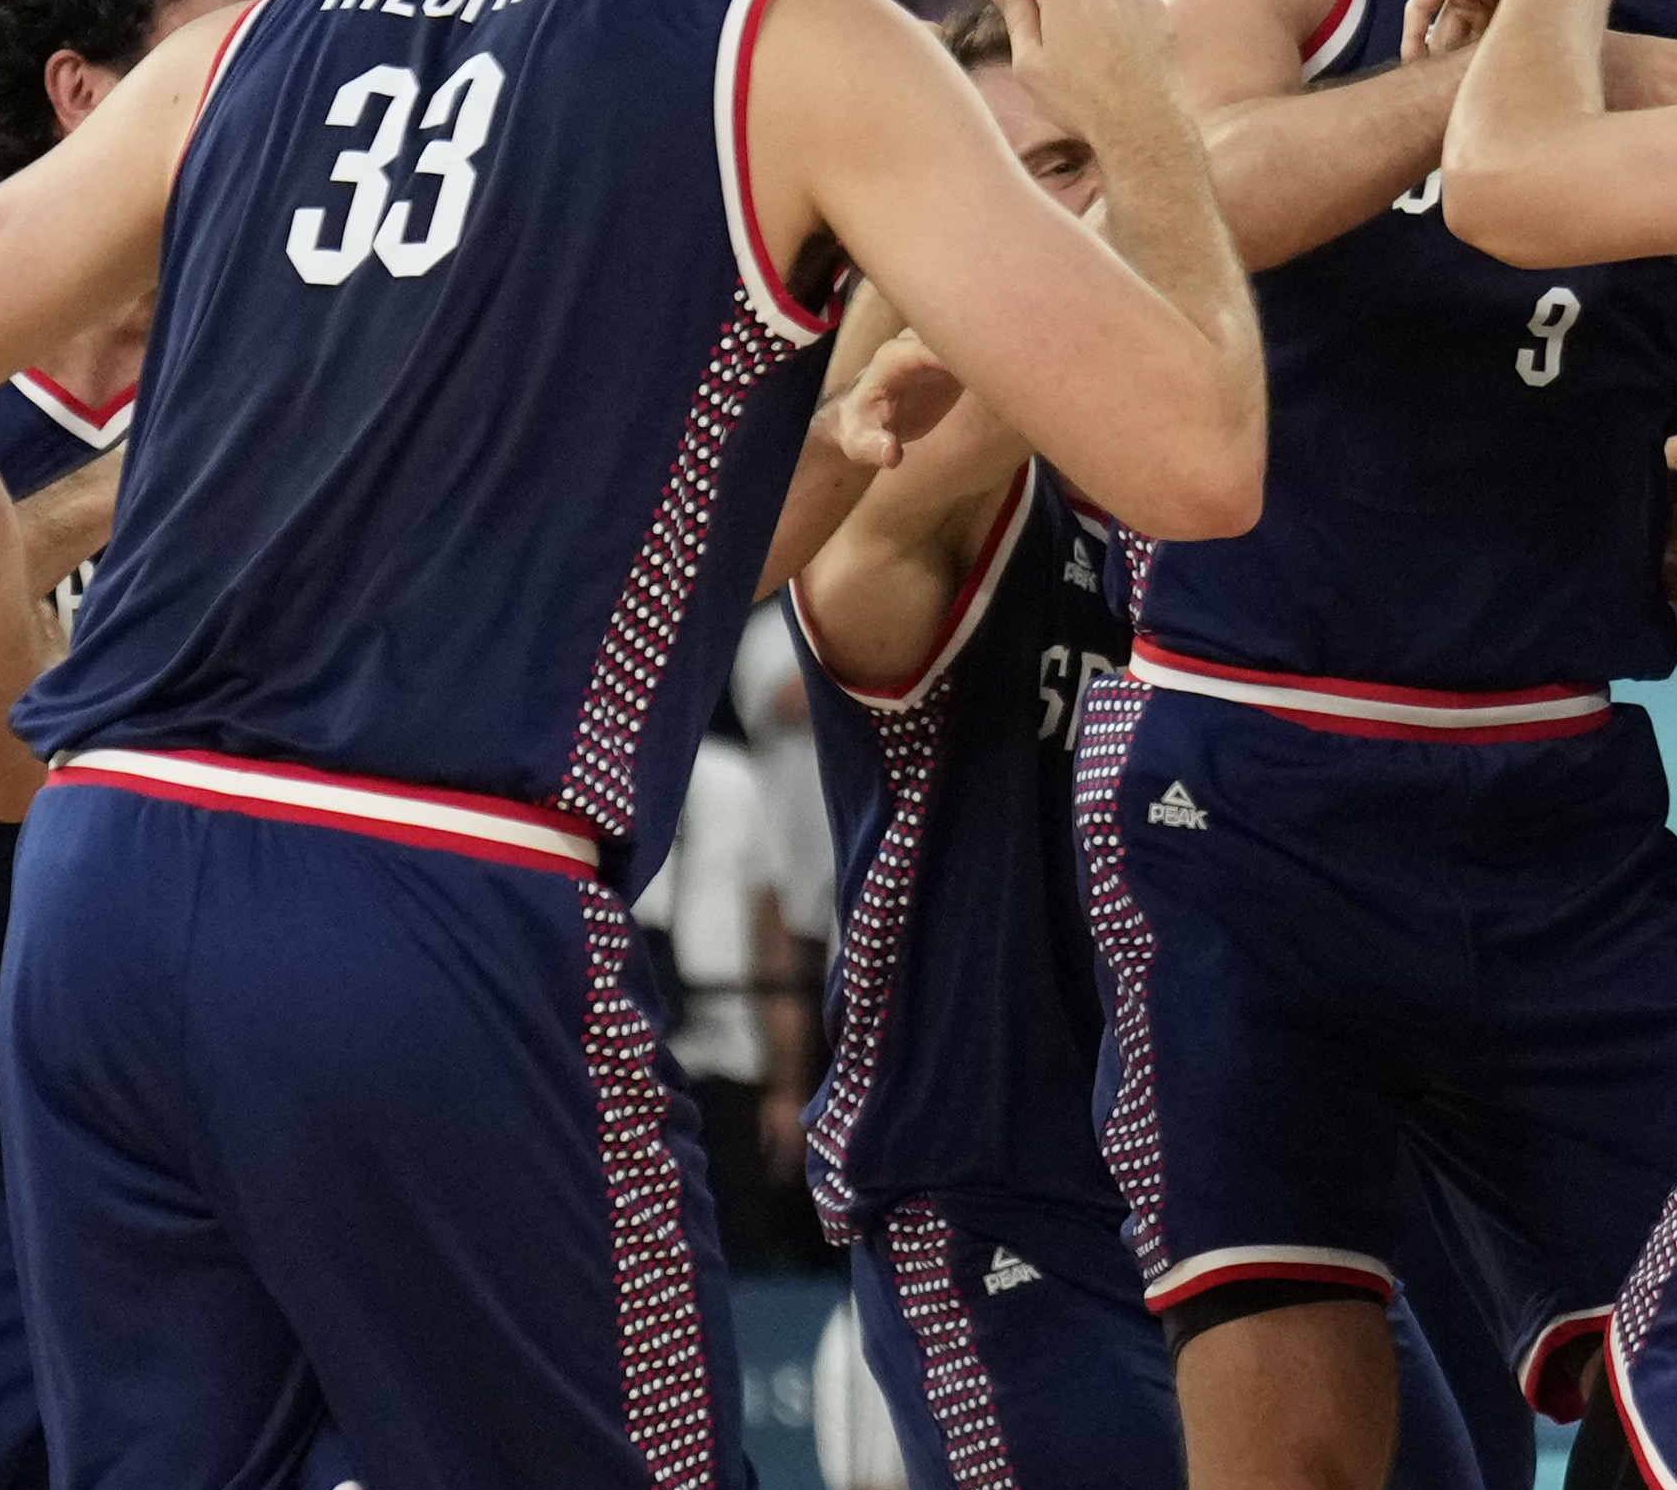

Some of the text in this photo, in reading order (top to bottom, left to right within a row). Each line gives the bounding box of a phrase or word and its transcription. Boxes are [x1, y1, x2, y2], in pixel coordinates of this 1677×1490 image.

[285, 51, 506, 287] 33
[1514, 286, 1582, 388] 9
[1147, 802, 1209, 831] PEAK
[982, 1262, 1043, 1297] PEAK
